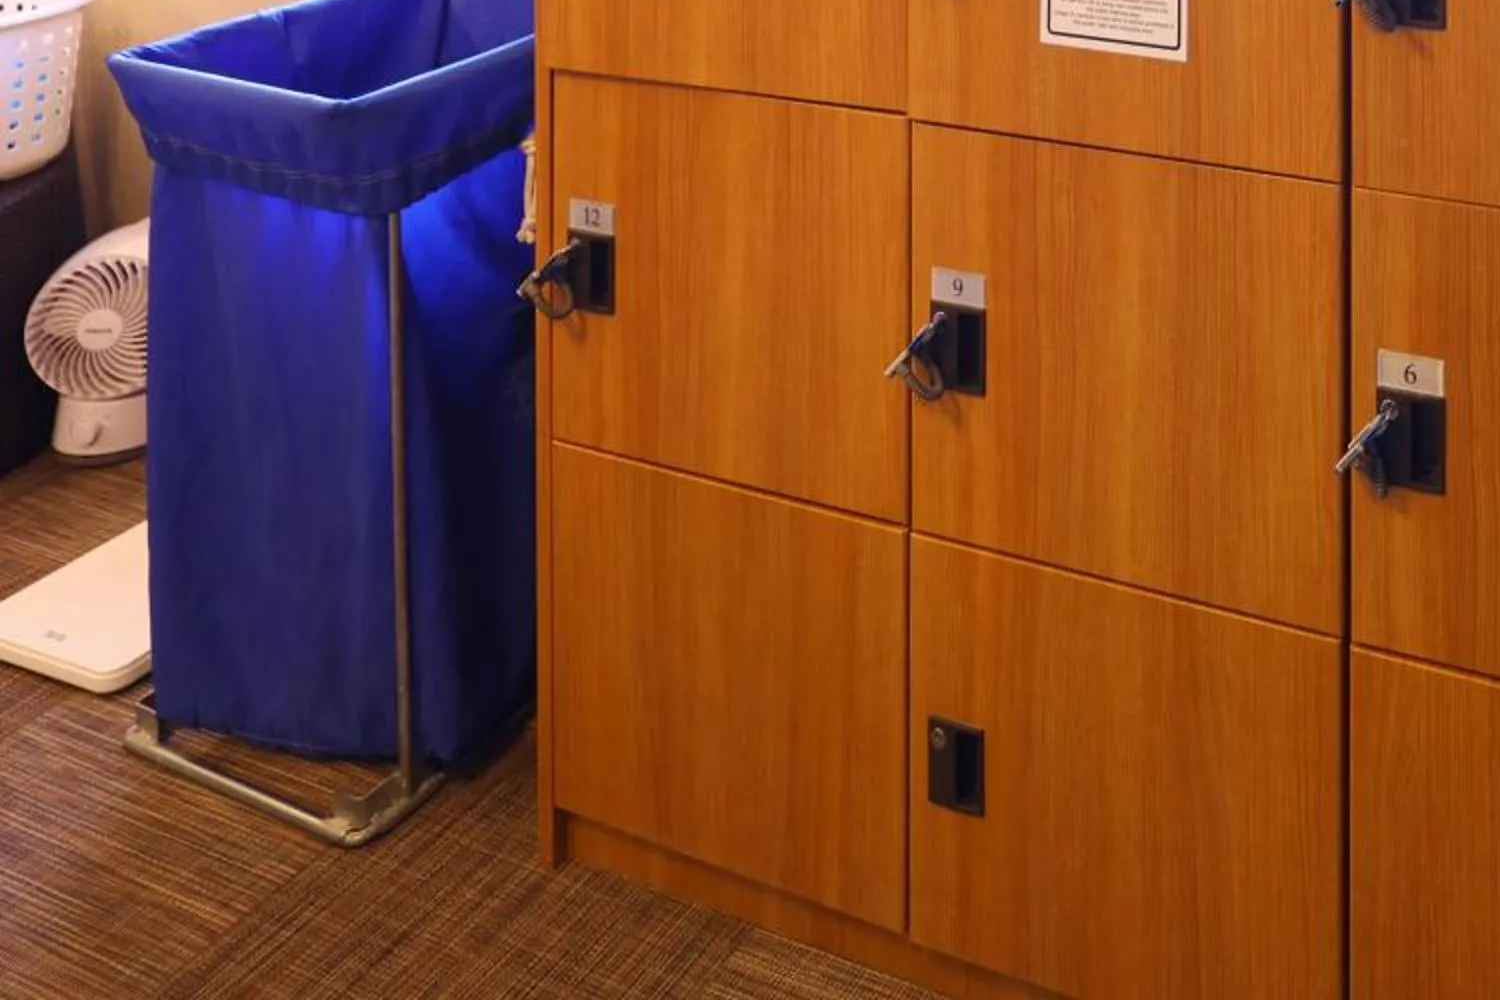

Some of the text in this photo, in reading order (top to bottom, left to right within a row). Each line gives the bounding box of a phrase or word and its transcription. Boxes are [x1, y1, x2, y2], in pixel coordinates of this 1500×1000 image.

[583, 206, 601, 227] 12
[952, 277, 964, 297] 9
[1403, 362, 1418, 385] 6
